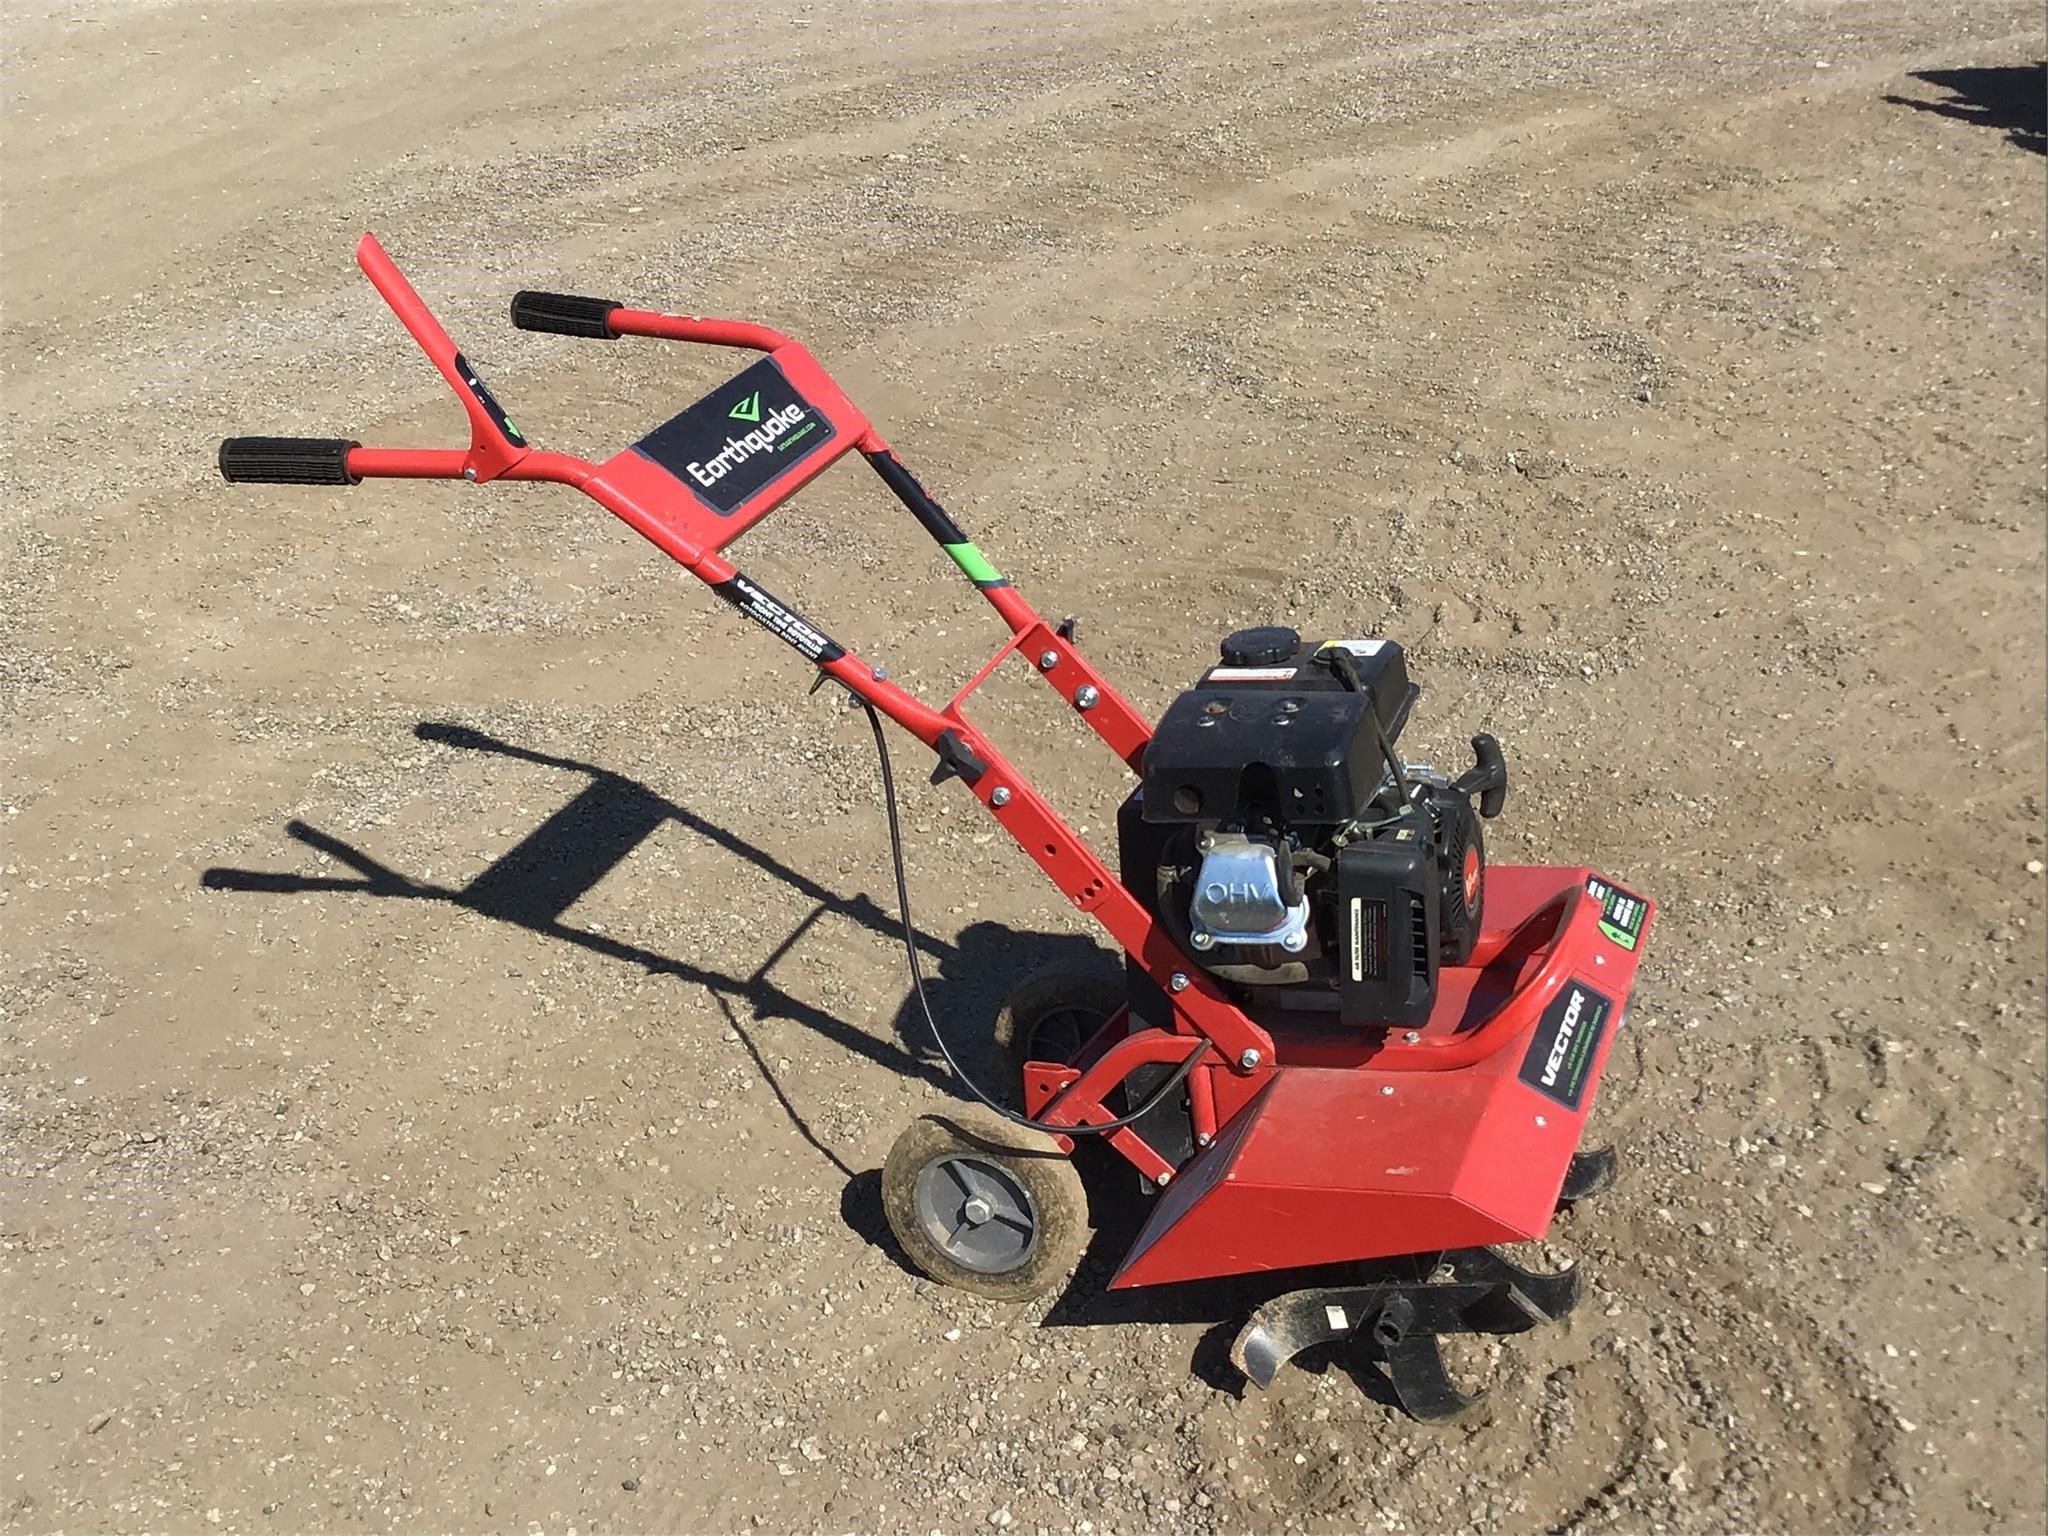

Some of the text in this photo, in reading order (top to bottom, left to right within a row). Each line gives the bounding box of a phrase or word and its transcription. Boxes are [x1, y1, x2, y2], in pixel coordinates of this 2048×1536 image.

[686, 403, 806, 488] Earthquake
[736, 579, 828, 646] VECTOR
[751, 600, 823, 655] FRONT TINE ROTOTILLER
[797, 643, 819, 659] AVANT
[1206, 882, 1270, 904] OHV
[1540, 989, 1585, 1087] VECTOR
